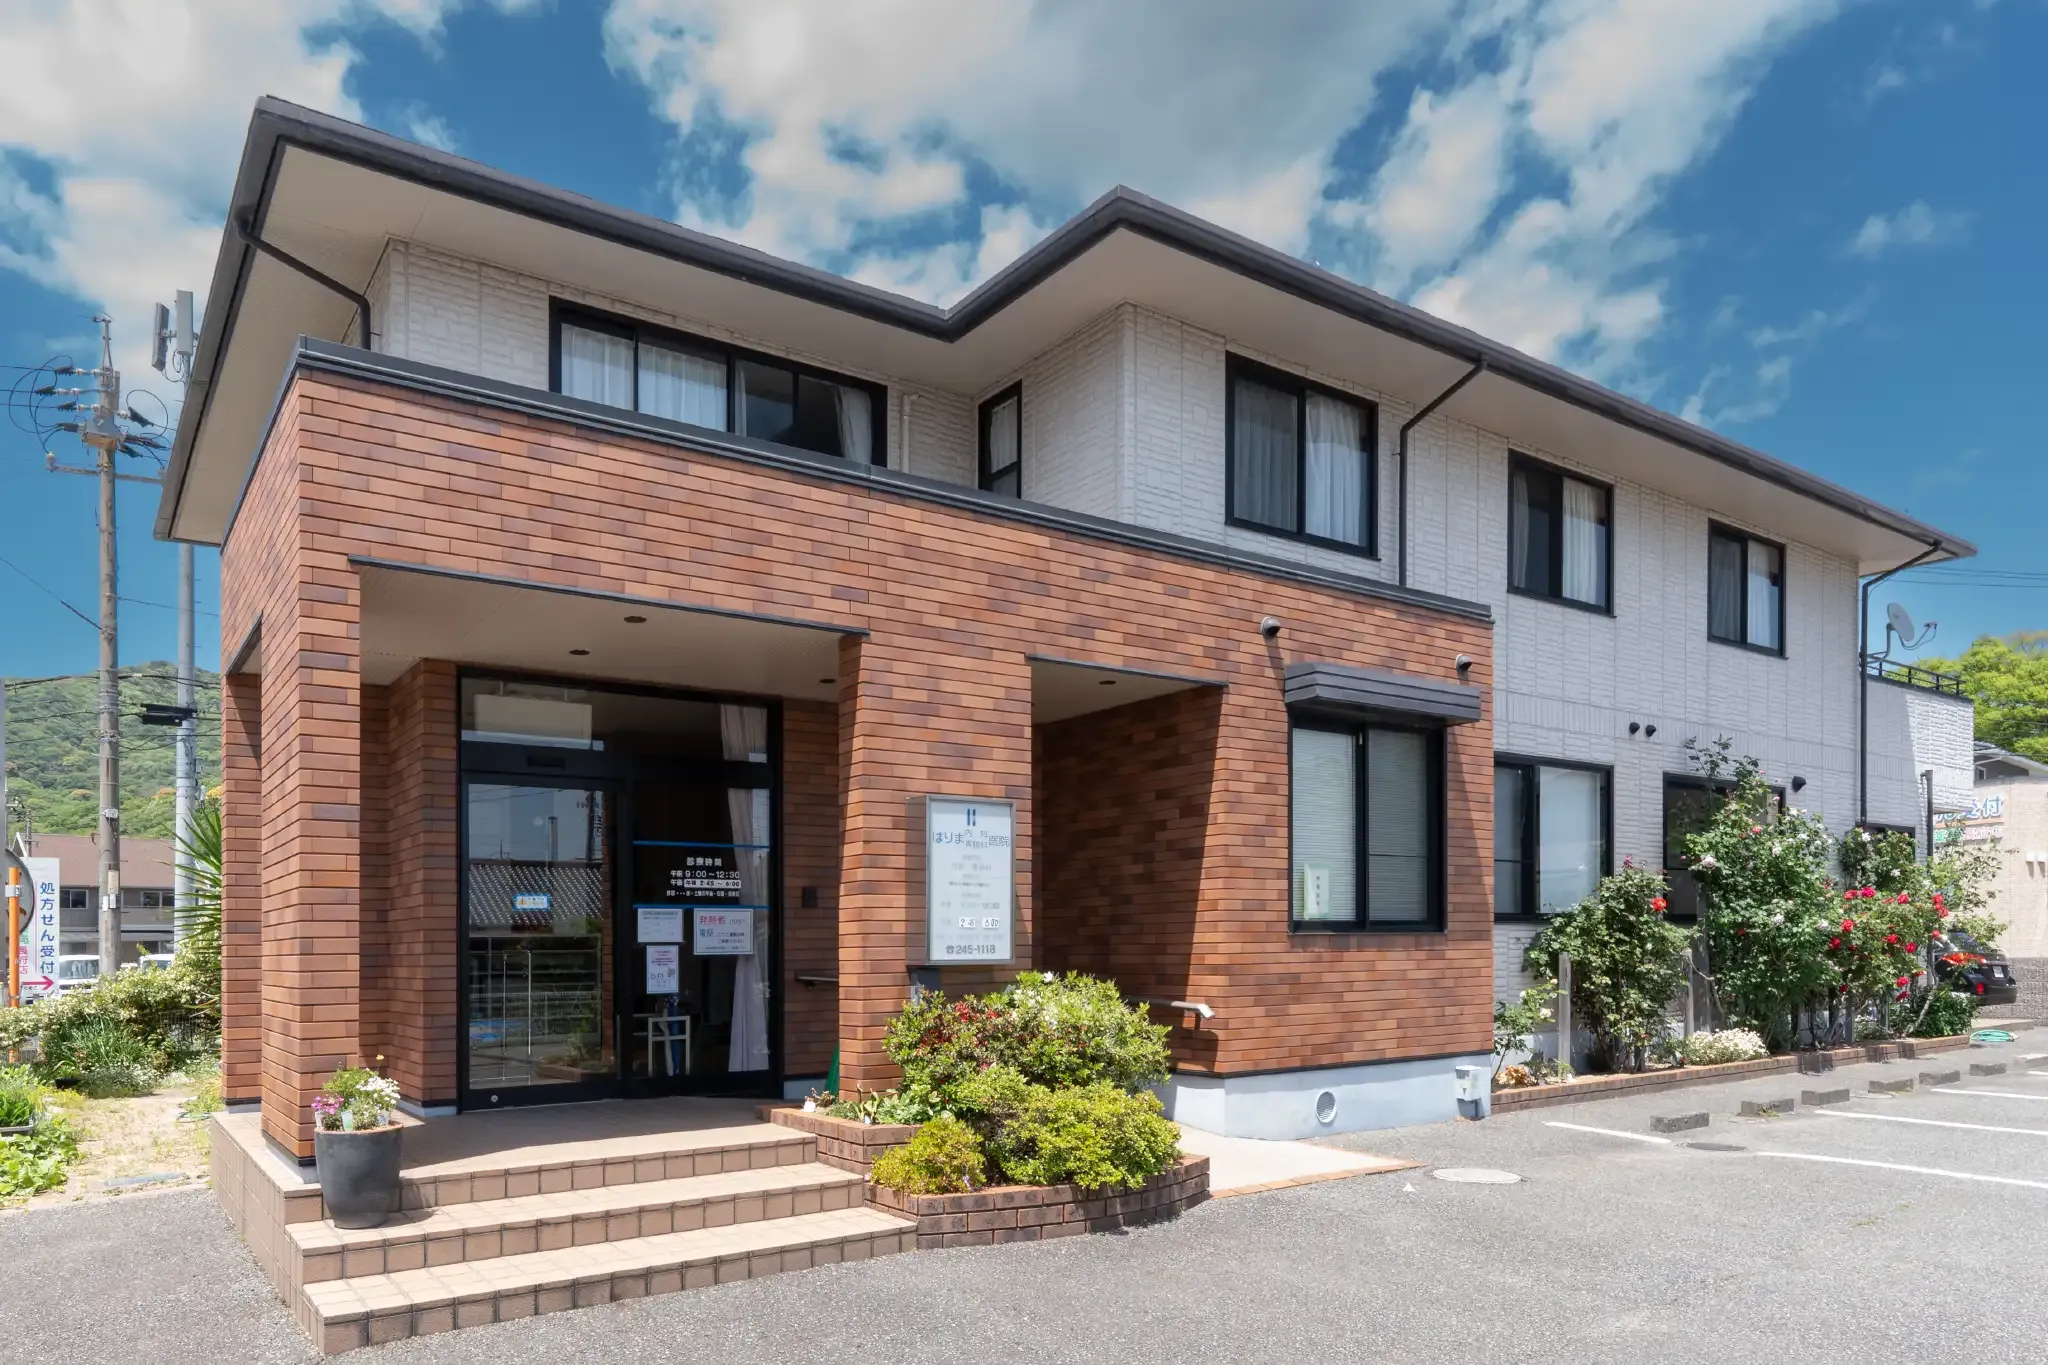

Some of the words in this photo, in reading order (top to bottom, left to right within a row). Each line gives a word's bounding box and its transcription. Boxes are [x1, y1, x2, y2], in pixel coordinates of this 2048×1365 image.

[932, 832, 965, 844] はりま
[988, 835, 1010, 847] 医院
[686, 857, 723, 867] 診療時間
[670, 870, 683, 878] 午前
[39, 881, 55, 975] 処方せん受付
[955, 944, 996, 955] 245-1118
